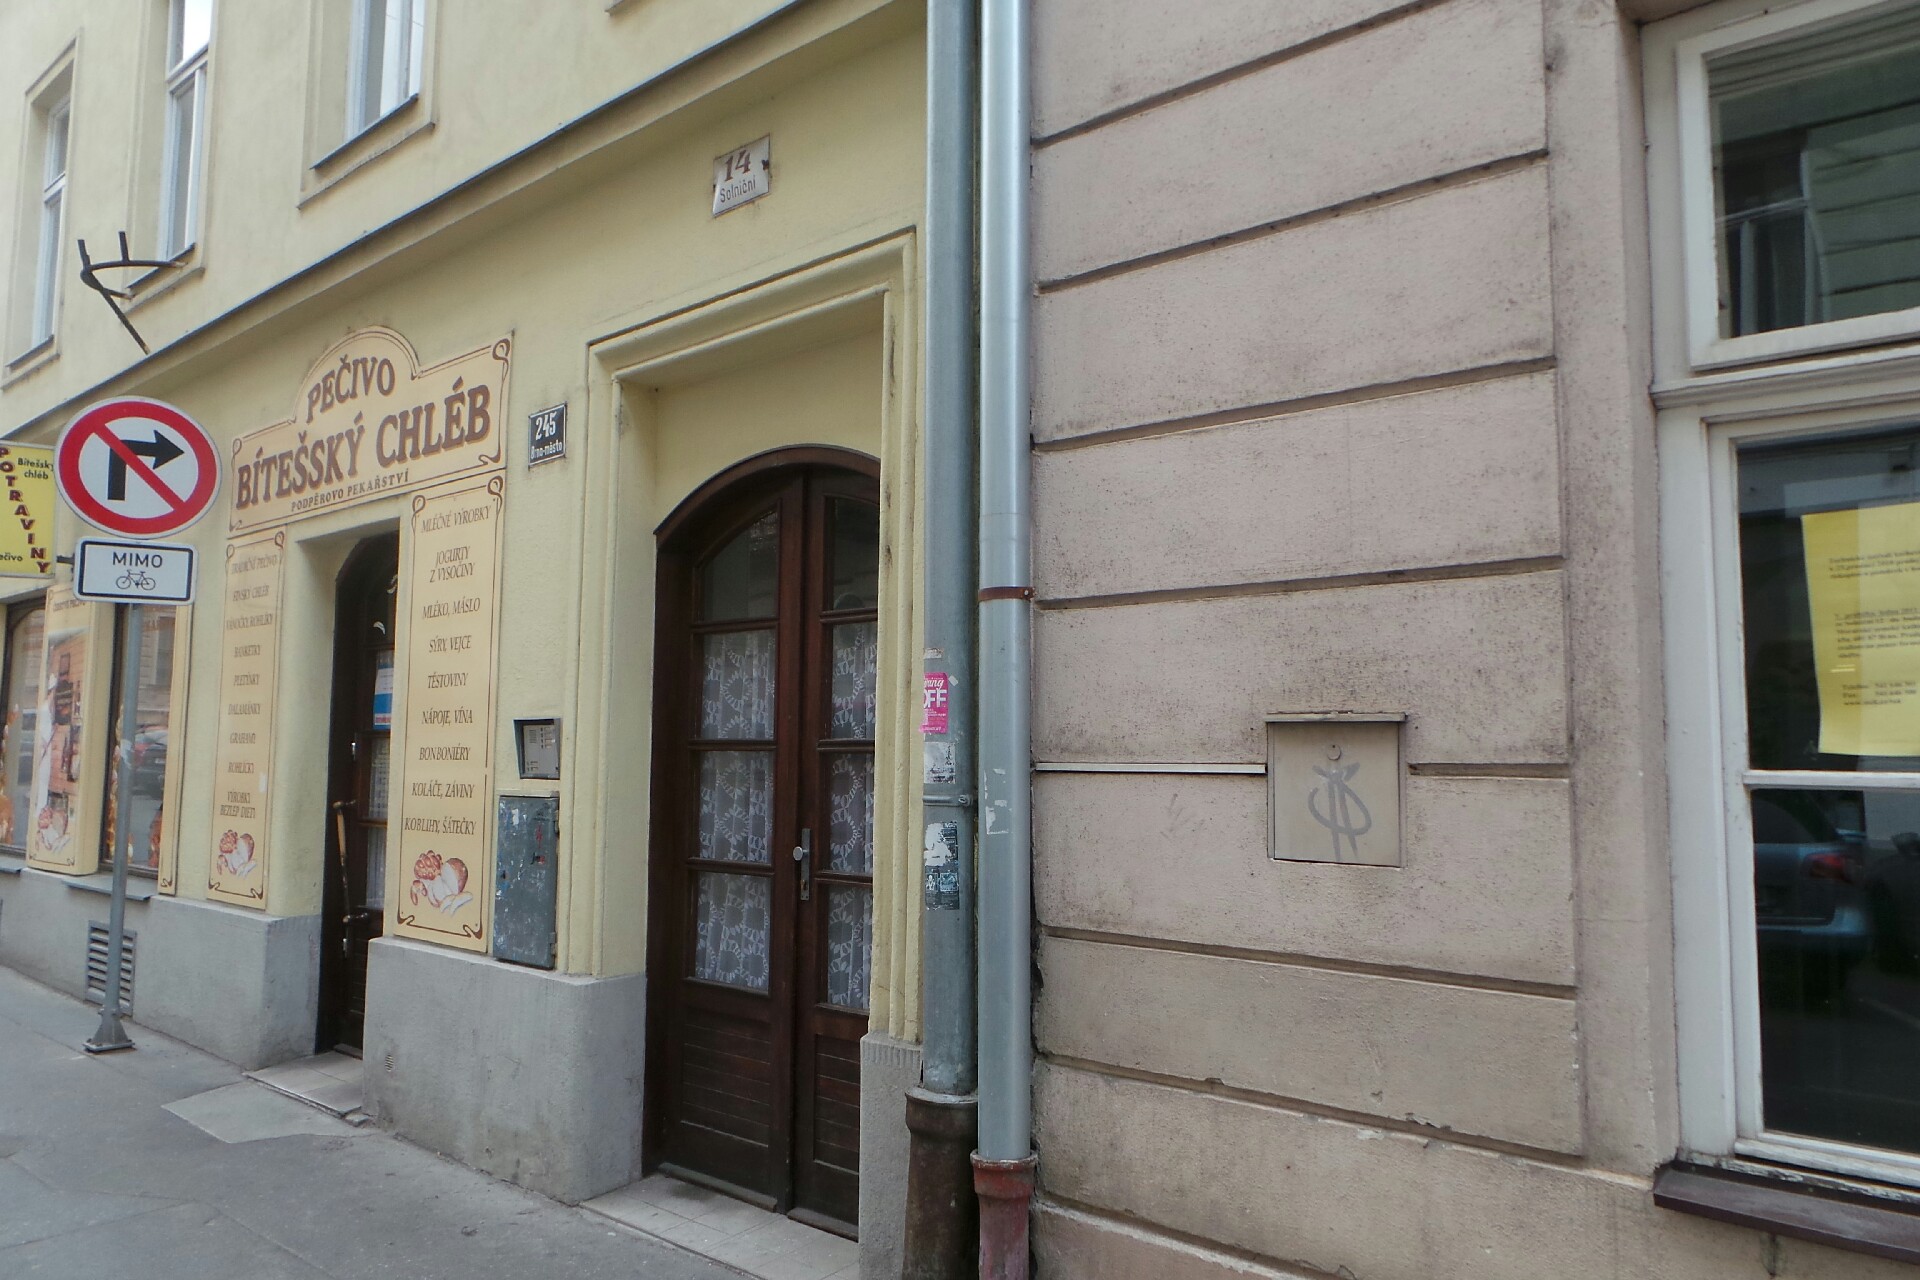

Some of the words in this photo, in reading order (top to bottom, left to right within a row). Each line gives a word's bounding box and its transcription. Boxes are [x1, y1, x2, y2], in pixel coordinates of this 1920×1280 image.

[725, 149, 751, 181] 14
[720, 175, 756, 203] Solniční
[306, 354, 396, 423] PEČIVO
[535, 411, 557, 440] 245
[235, 411, 365, 509] BÍTEŠSKÝ
[376, 376, 491, 467] CHLÉB
[24, 469, 49, 479] chléb
[291, 488, 344, 512] PODPĚROVO
[347, 468, 409, 497] PEKAŘSTVÍ
[421, 510, 452, 533] MLÉČNÉ
[454, 505, 491, 526] VÝROBKY
[0, 552, 23, 561] ečivo
[112, 552, 163, 568] MIMO
[436, 546, 470, 567] JOGURTY
[429, 569, 436, 583] Z
[438, 561, 475, 581] VYSOČINY
[423, 600, 450, 619] MLÉKO,
[452, 596, 481, 614] MÁSLO
[450, 635, 472, 653] VEJCE
[428, 672, 468, 689] TĚSTOVINY
[422, 707, 451, 727] NÁPOJE,
[454, 706, 473, 724] VÍNA
[419, 743, 471, 761] BONBONIÉRY
[412, 780, 442, 799] KOLÁČE,
[445, 781, 474, 798] ZÁVINY
[404, 818, 440, 834] KOBLIHY,
[443, 816, 476, 835] ŠÁTEČKY
